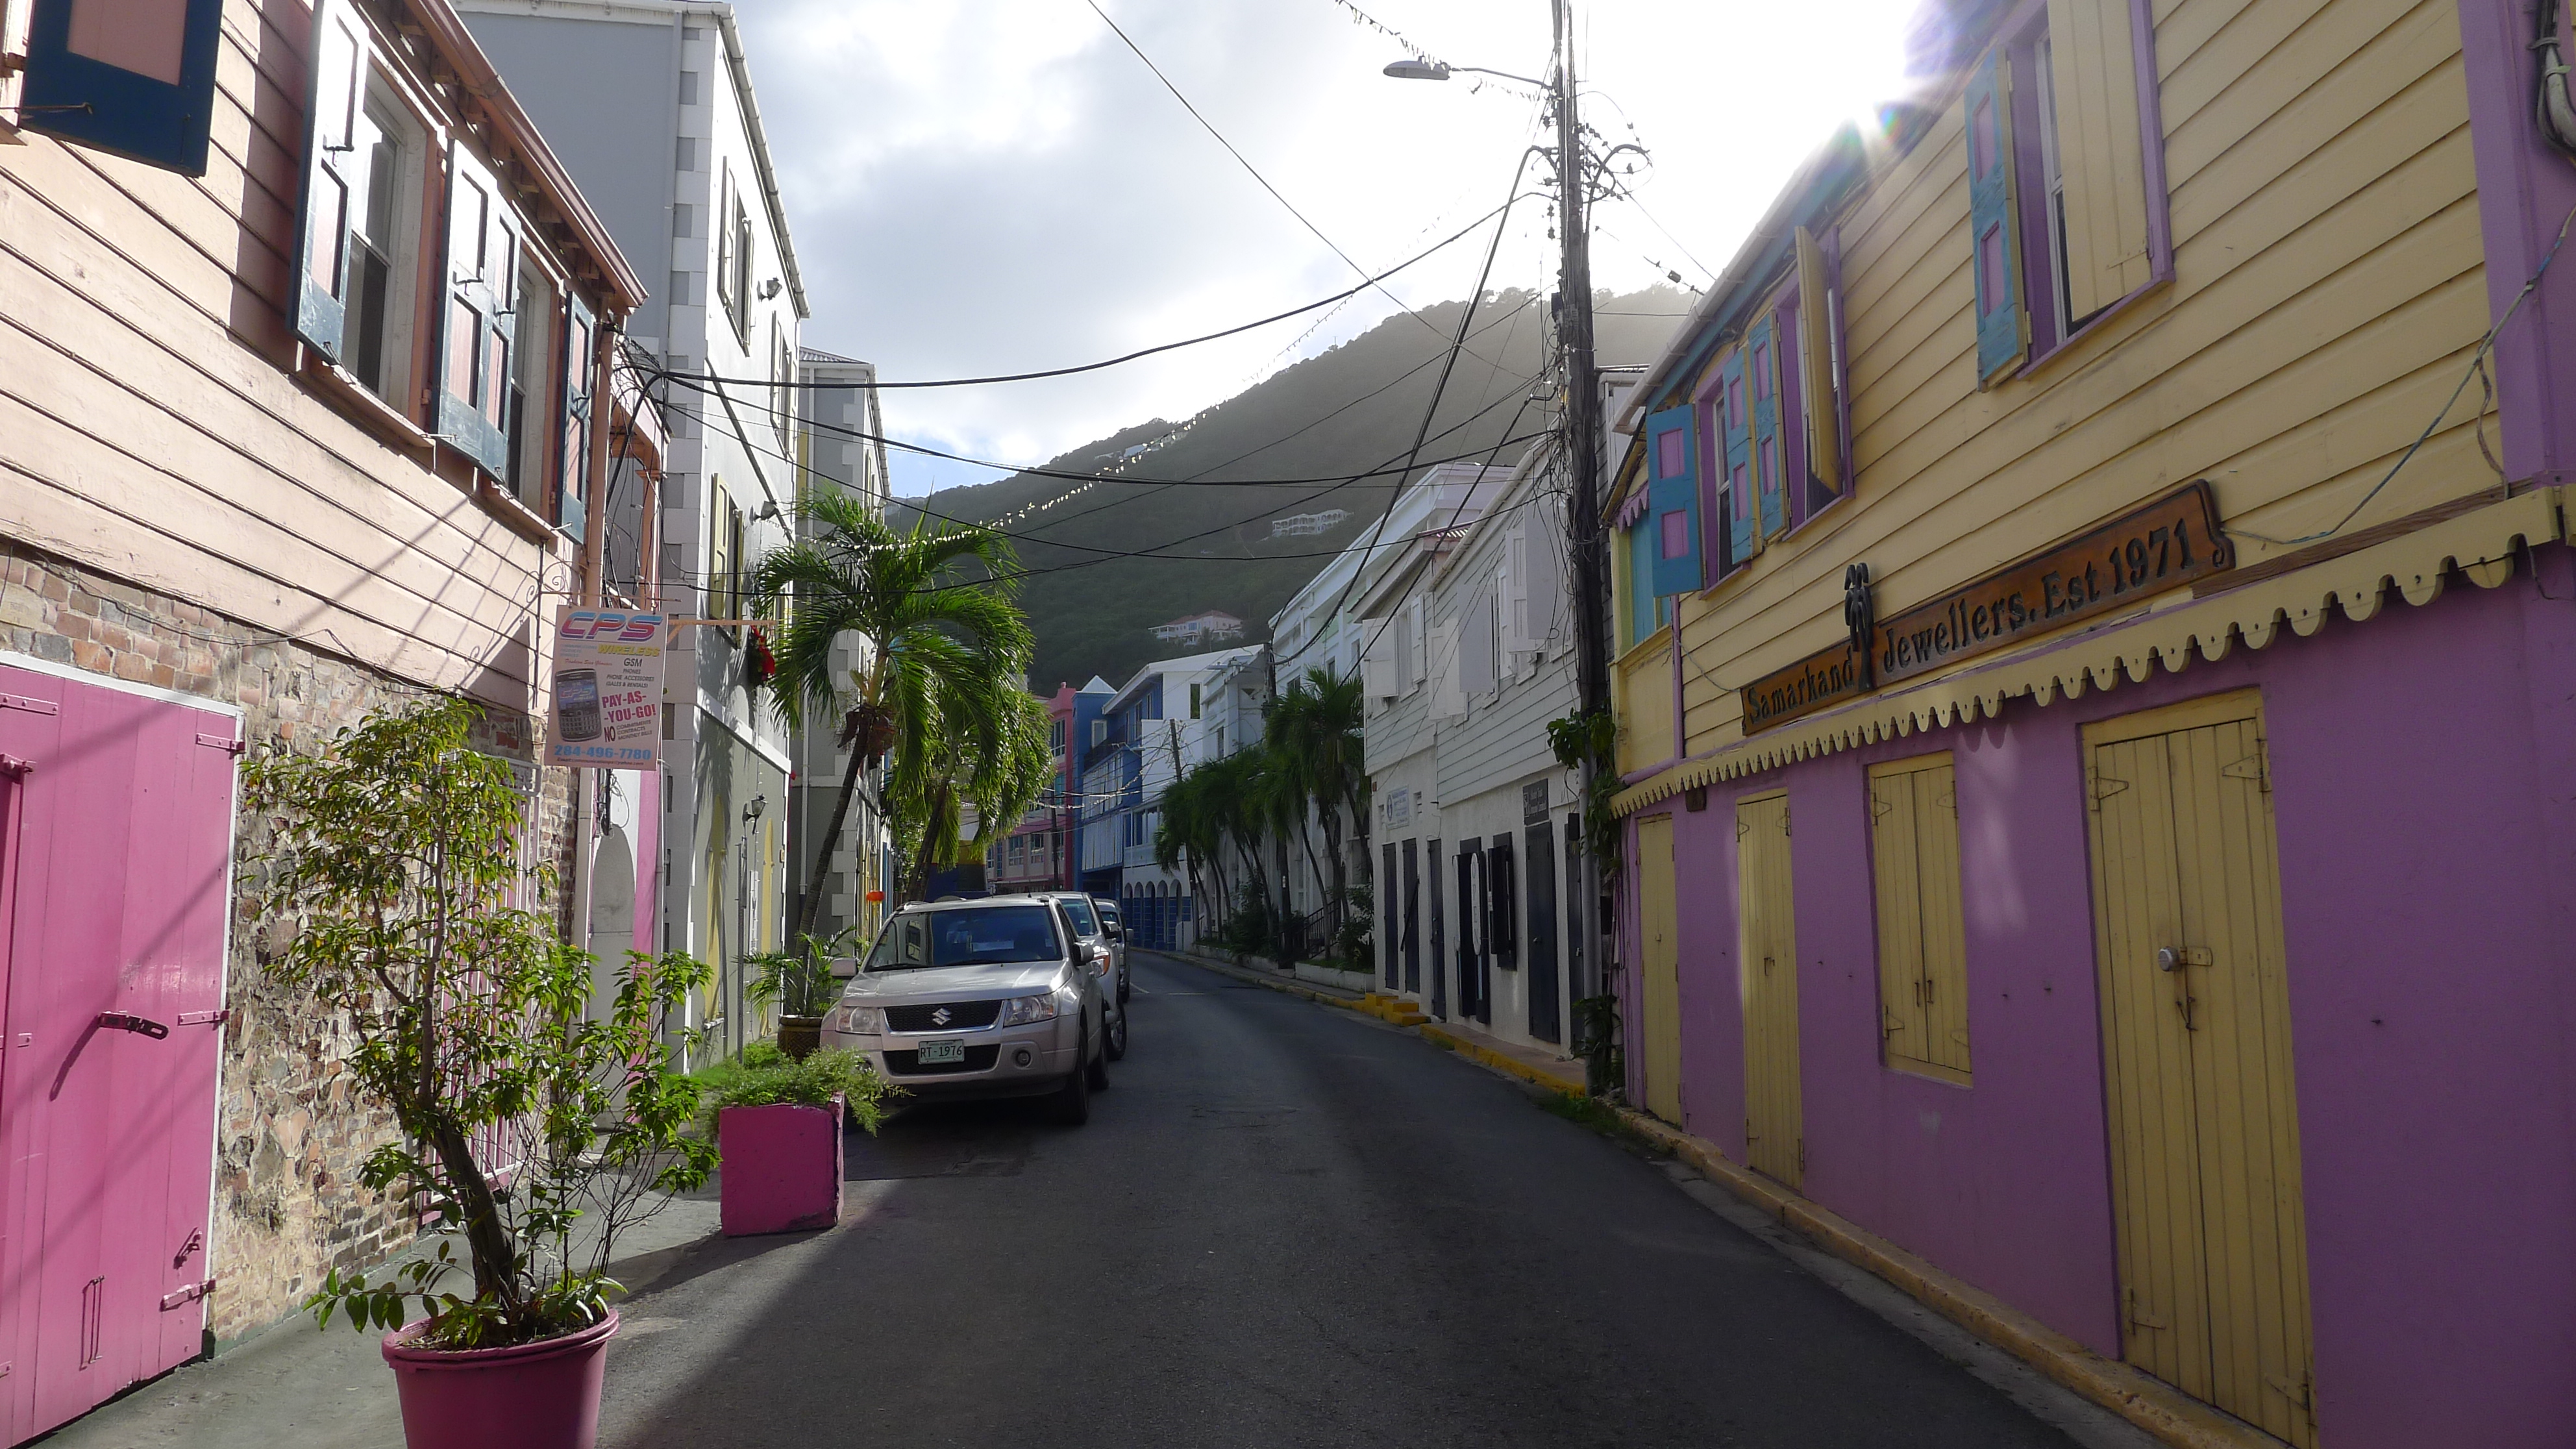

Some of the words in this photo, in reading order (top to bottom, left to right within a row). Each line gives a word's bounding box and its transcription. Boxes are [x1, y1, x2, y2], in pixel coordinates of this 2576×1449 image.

[560, 611, 663, 642] CPS
[1748, 646, 1855, 724] Samarkand
[2042, 560, 2100, 619] Est
[2109, 517, 2195, 595] 1971
[597, 644, 661, 657] WIRELESS
[624, 658, 642, 667] GSM
[601, 690, 647, 708] PAY-AS-
[604, 704, 656, 723] -YOU-GO!
[604, 725, 616, 743] NO
[617, 726, 645, 735] CONTRACTS
[554, 744, 651, 760] 284-496-7780
[1471, 861, 1480, 945] OPEN
